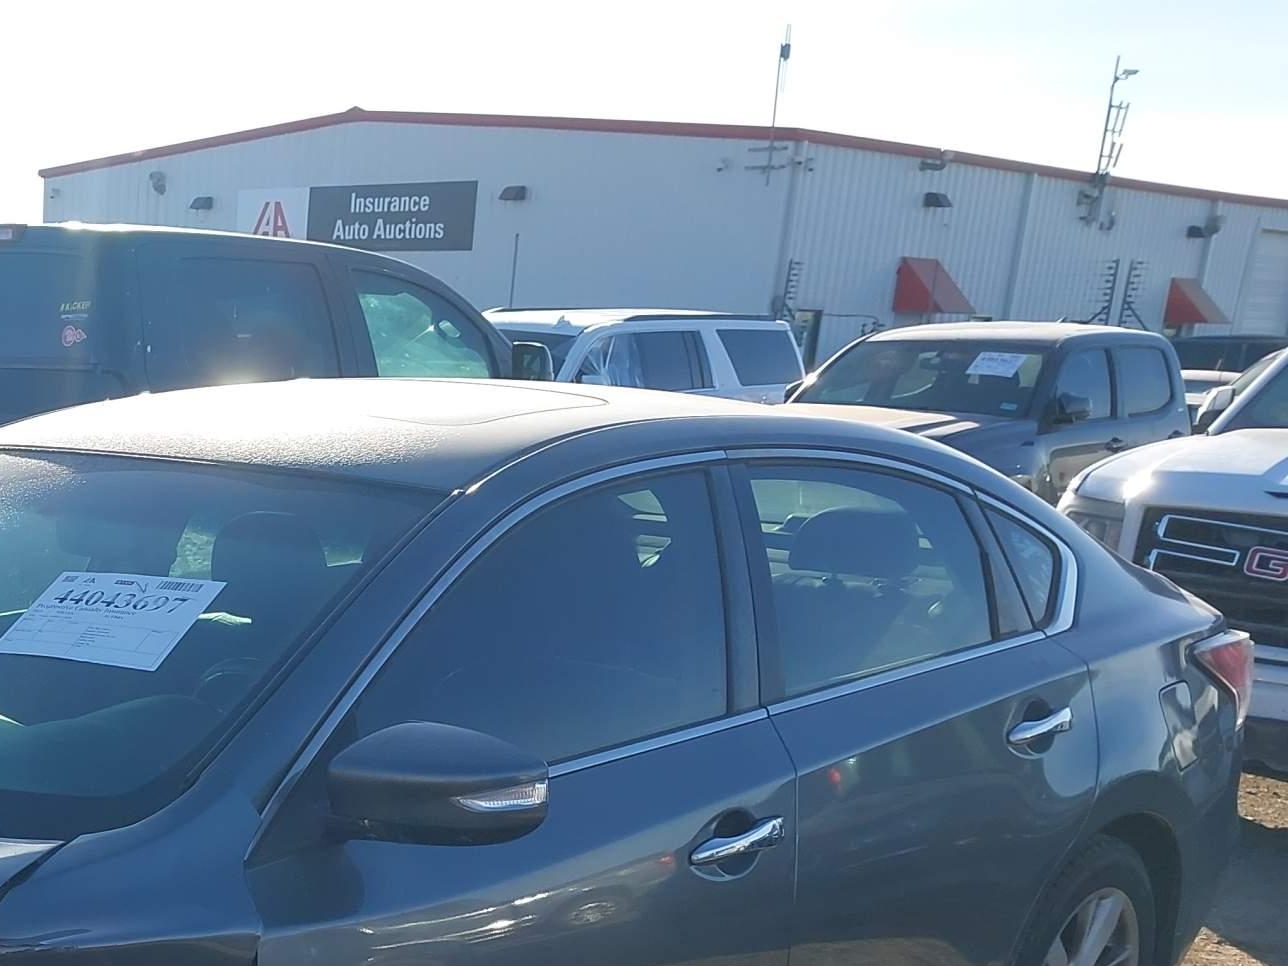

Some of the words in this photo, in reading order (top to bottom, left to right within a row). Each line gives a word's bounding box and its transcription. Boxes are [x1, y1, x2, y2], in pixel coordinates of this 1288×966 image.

[350, 192, 431, 214] Insurance
[332, 219, 369, 240] Auto
[373, 218, 445, 241] Auctions
[53, 588, 193, 614] 44043697
